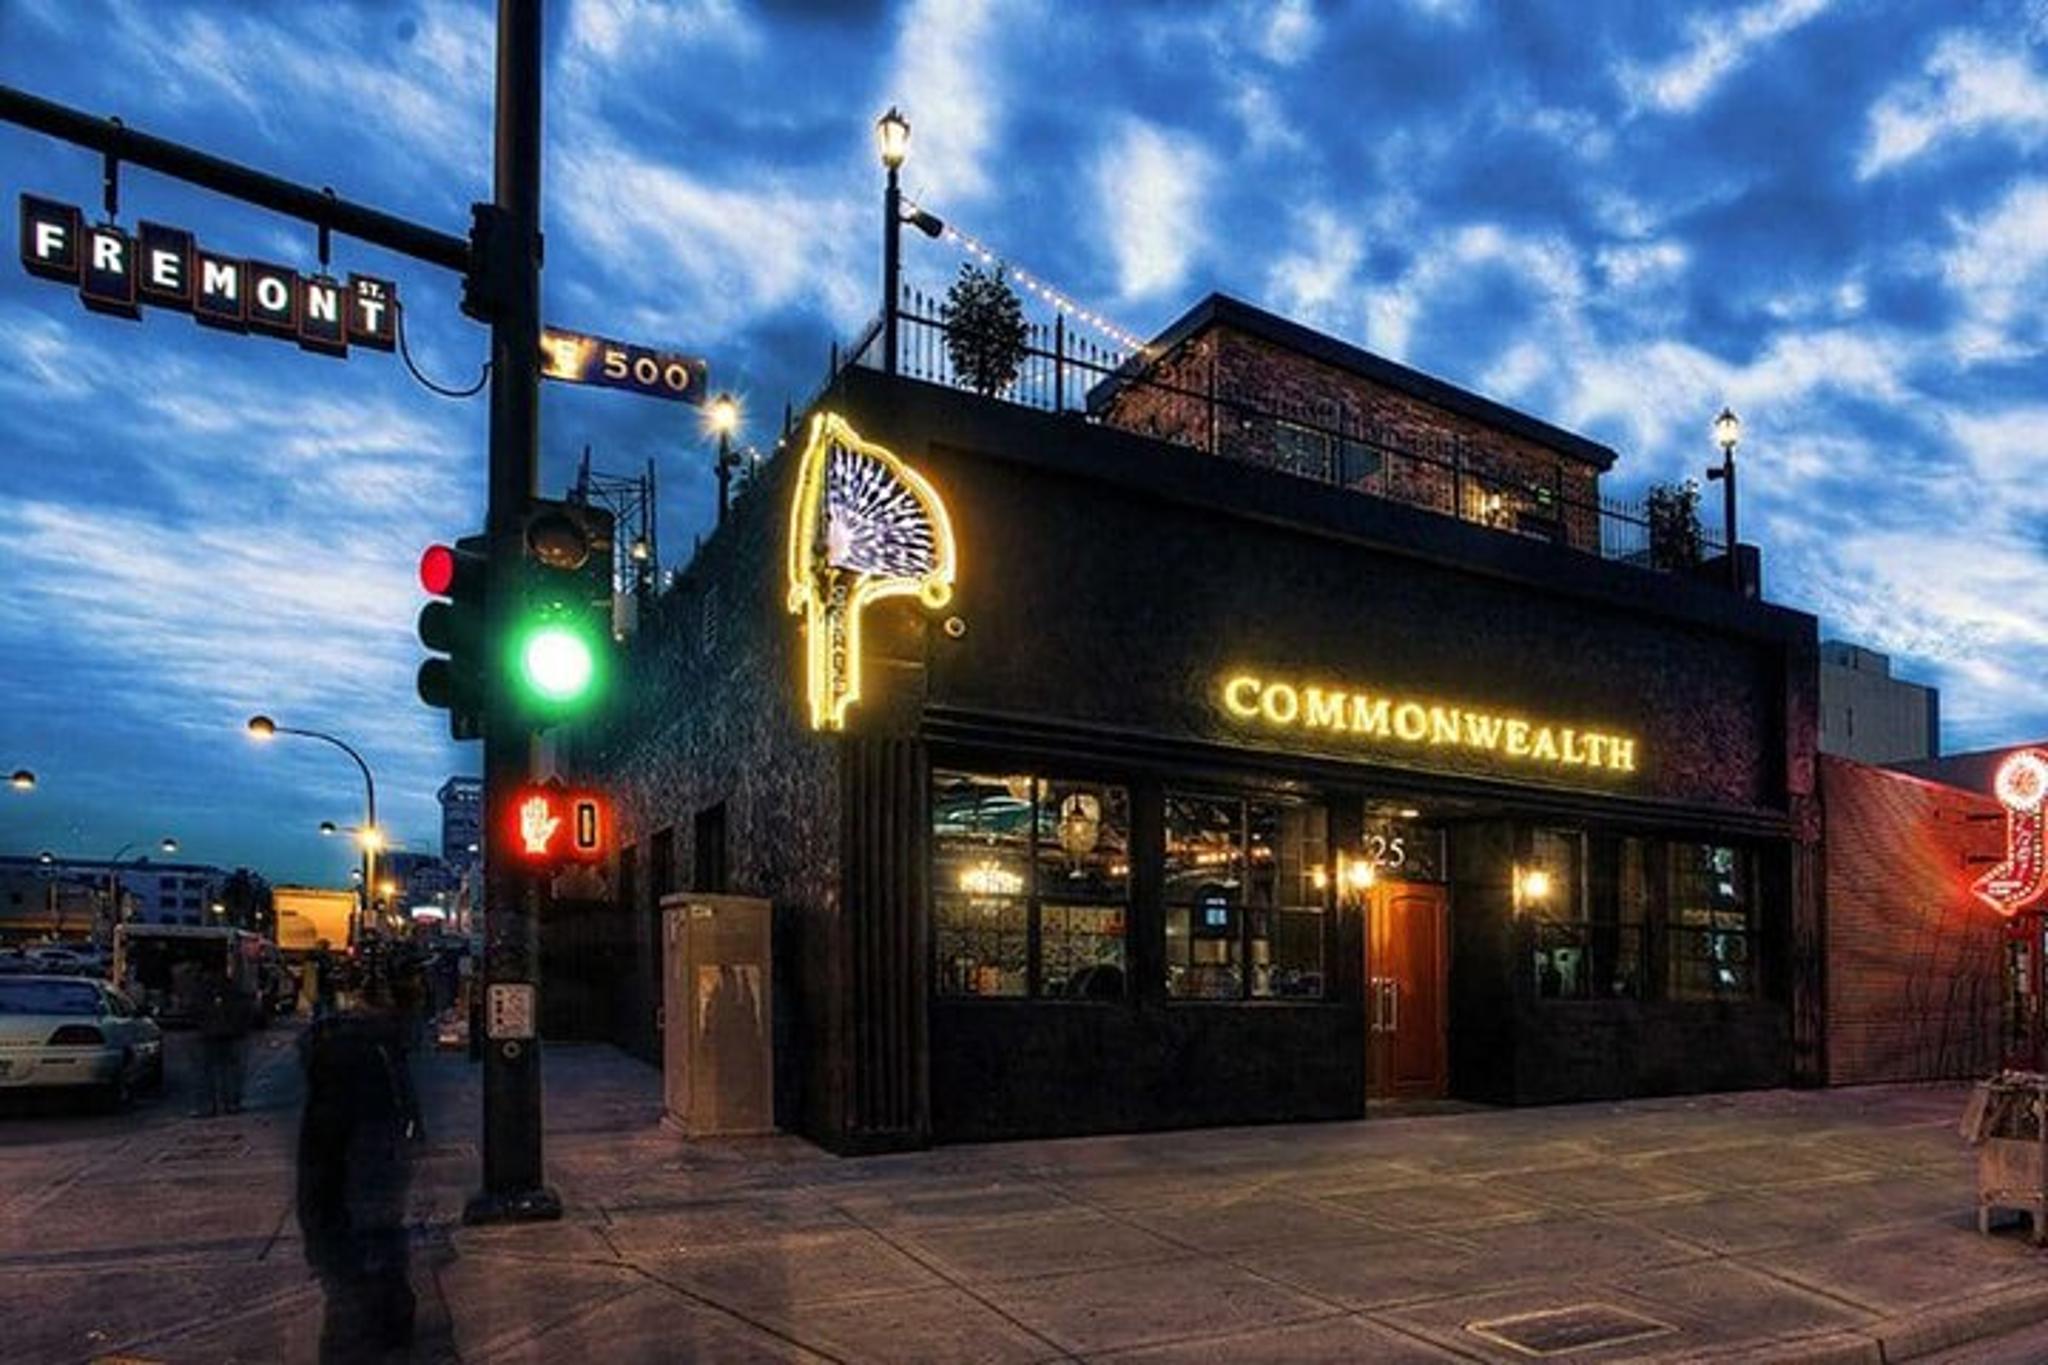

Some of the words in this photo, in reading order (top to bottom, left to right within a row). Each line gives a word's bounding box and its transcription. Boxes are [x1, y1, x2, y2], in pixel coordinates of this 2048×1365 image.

[35, 221, 385, 332] FREMONT
[603, 350, 688, 391] 500
[1224, 676, 1636, 771] COMMONWEALTH
